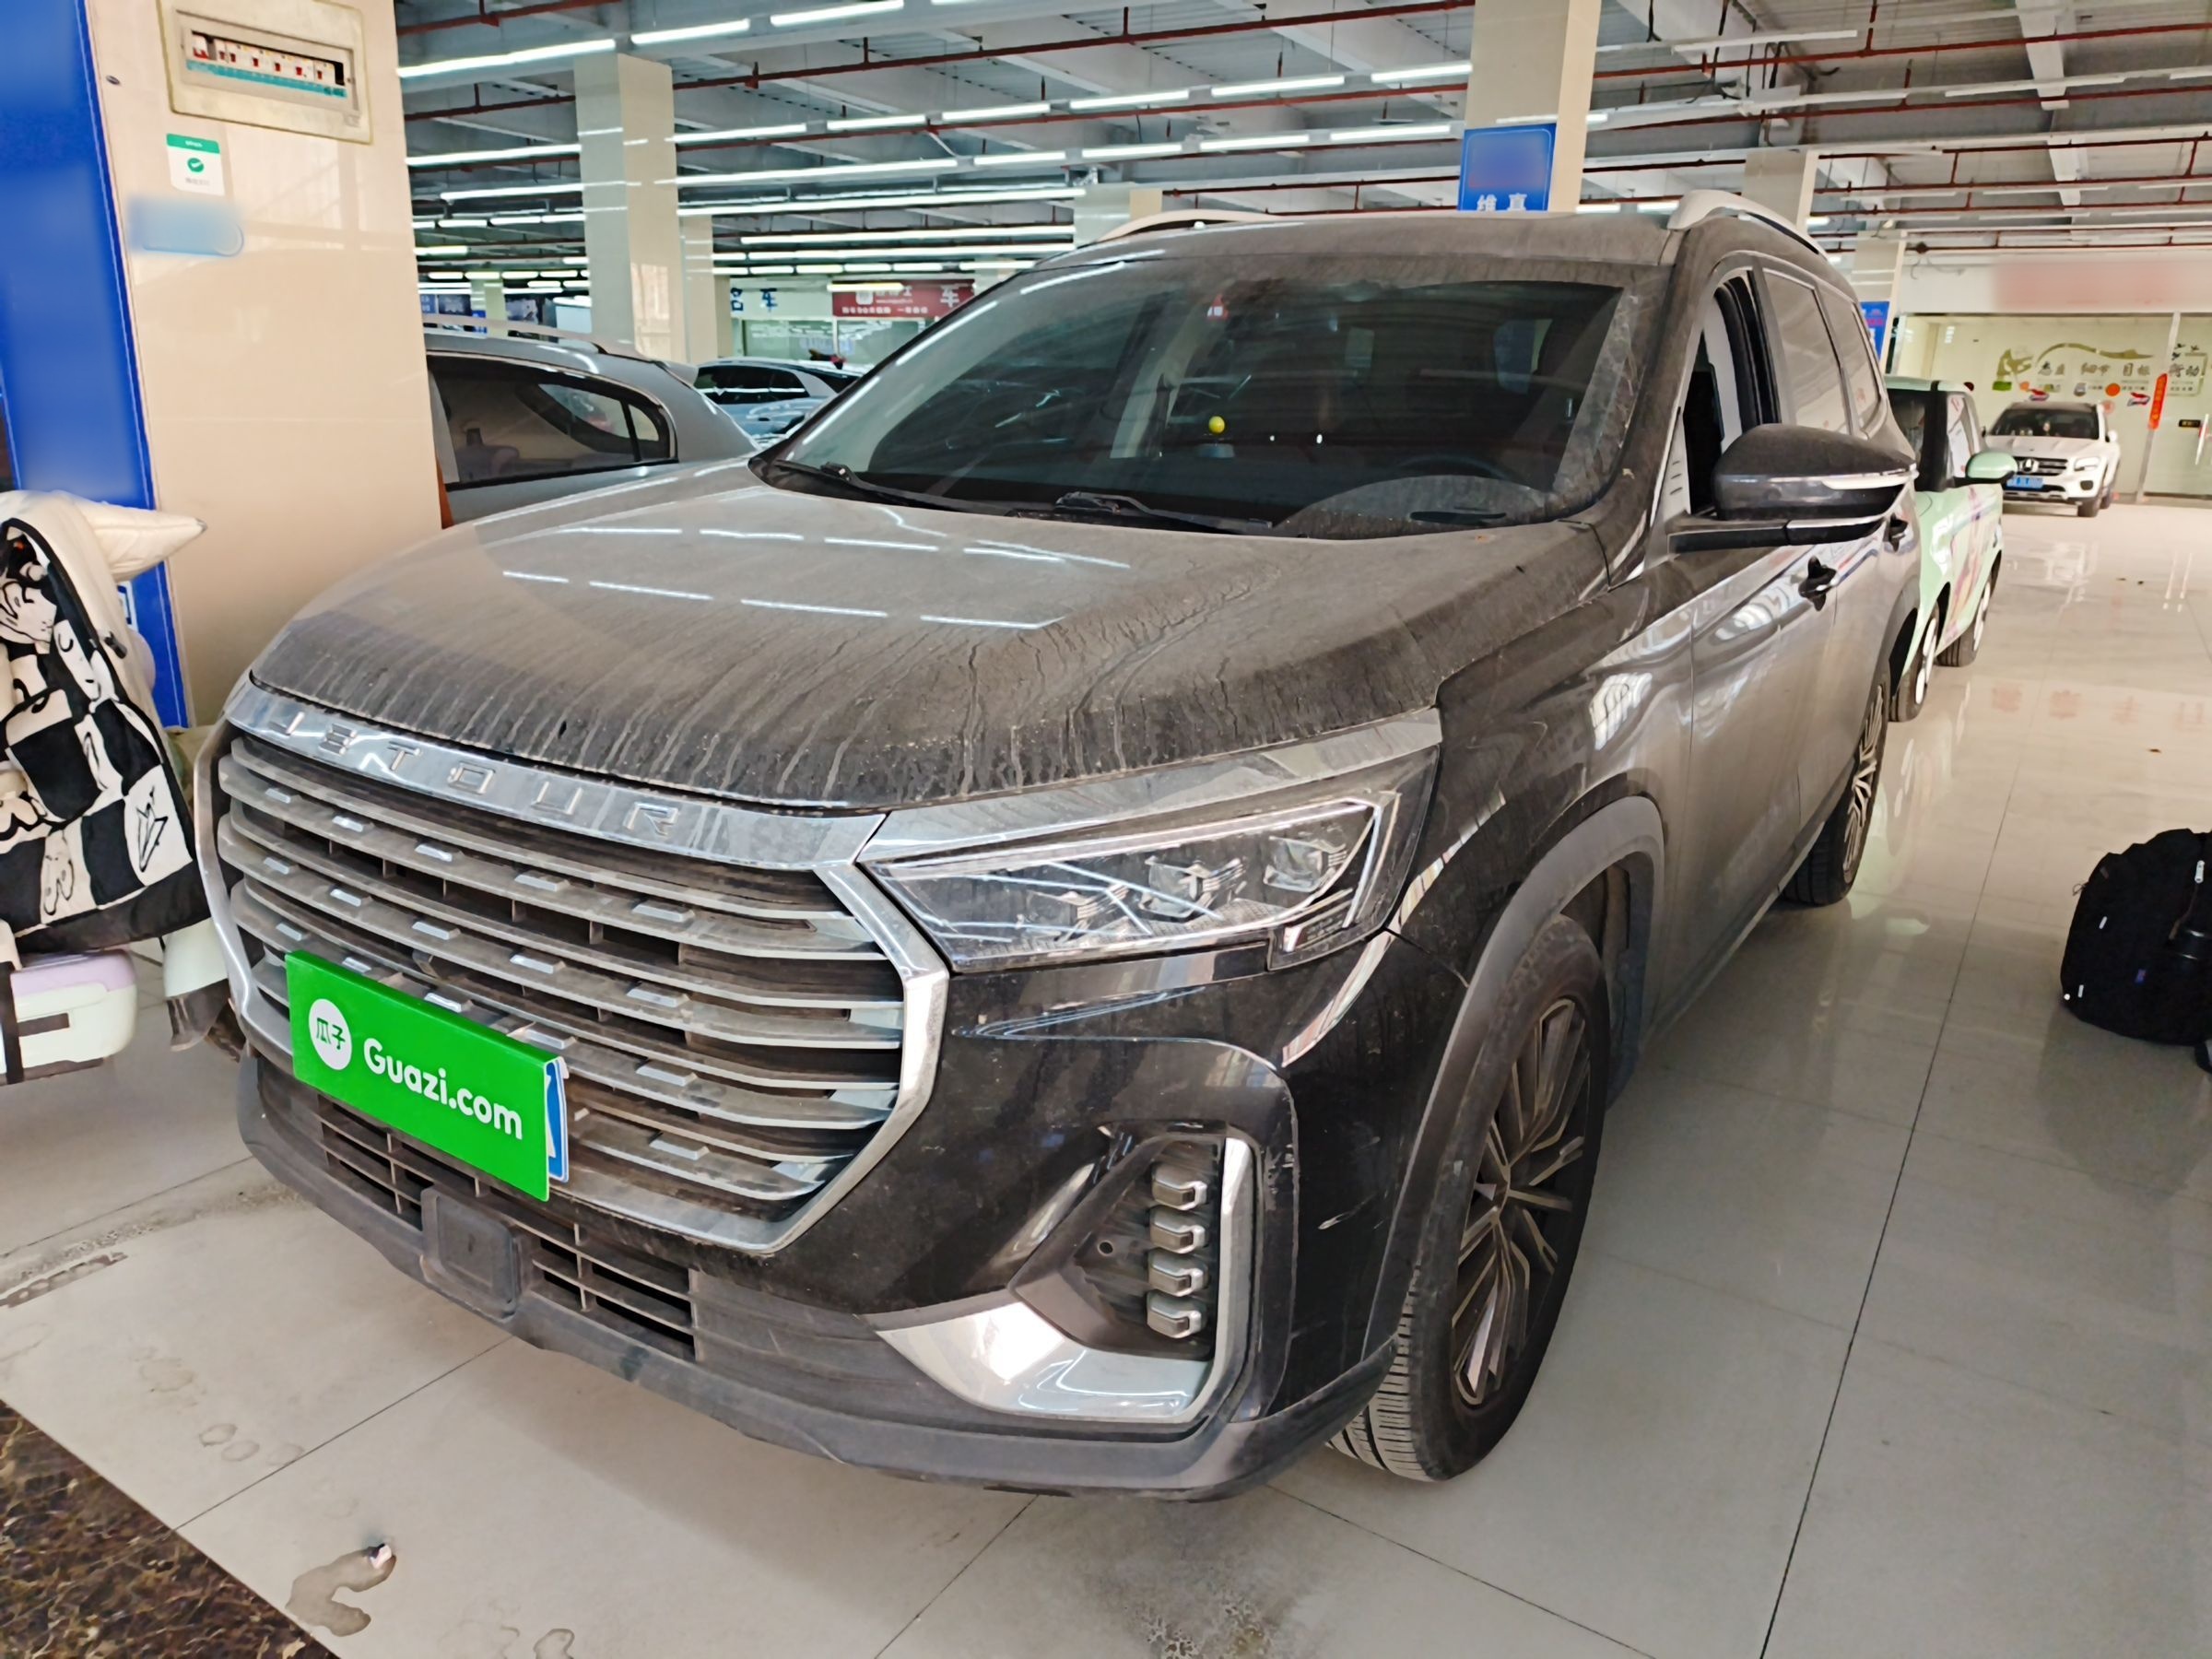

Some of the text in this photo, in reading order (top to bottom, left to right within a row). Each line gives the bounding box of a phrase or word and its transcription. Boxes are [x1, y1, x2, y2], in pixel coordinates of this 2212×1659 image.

[269, 711, 680, 836] JETOUR
[316, 1017, 346, 1050] 瓜子
[363, 1037, 523, 1141] Guazi.com
